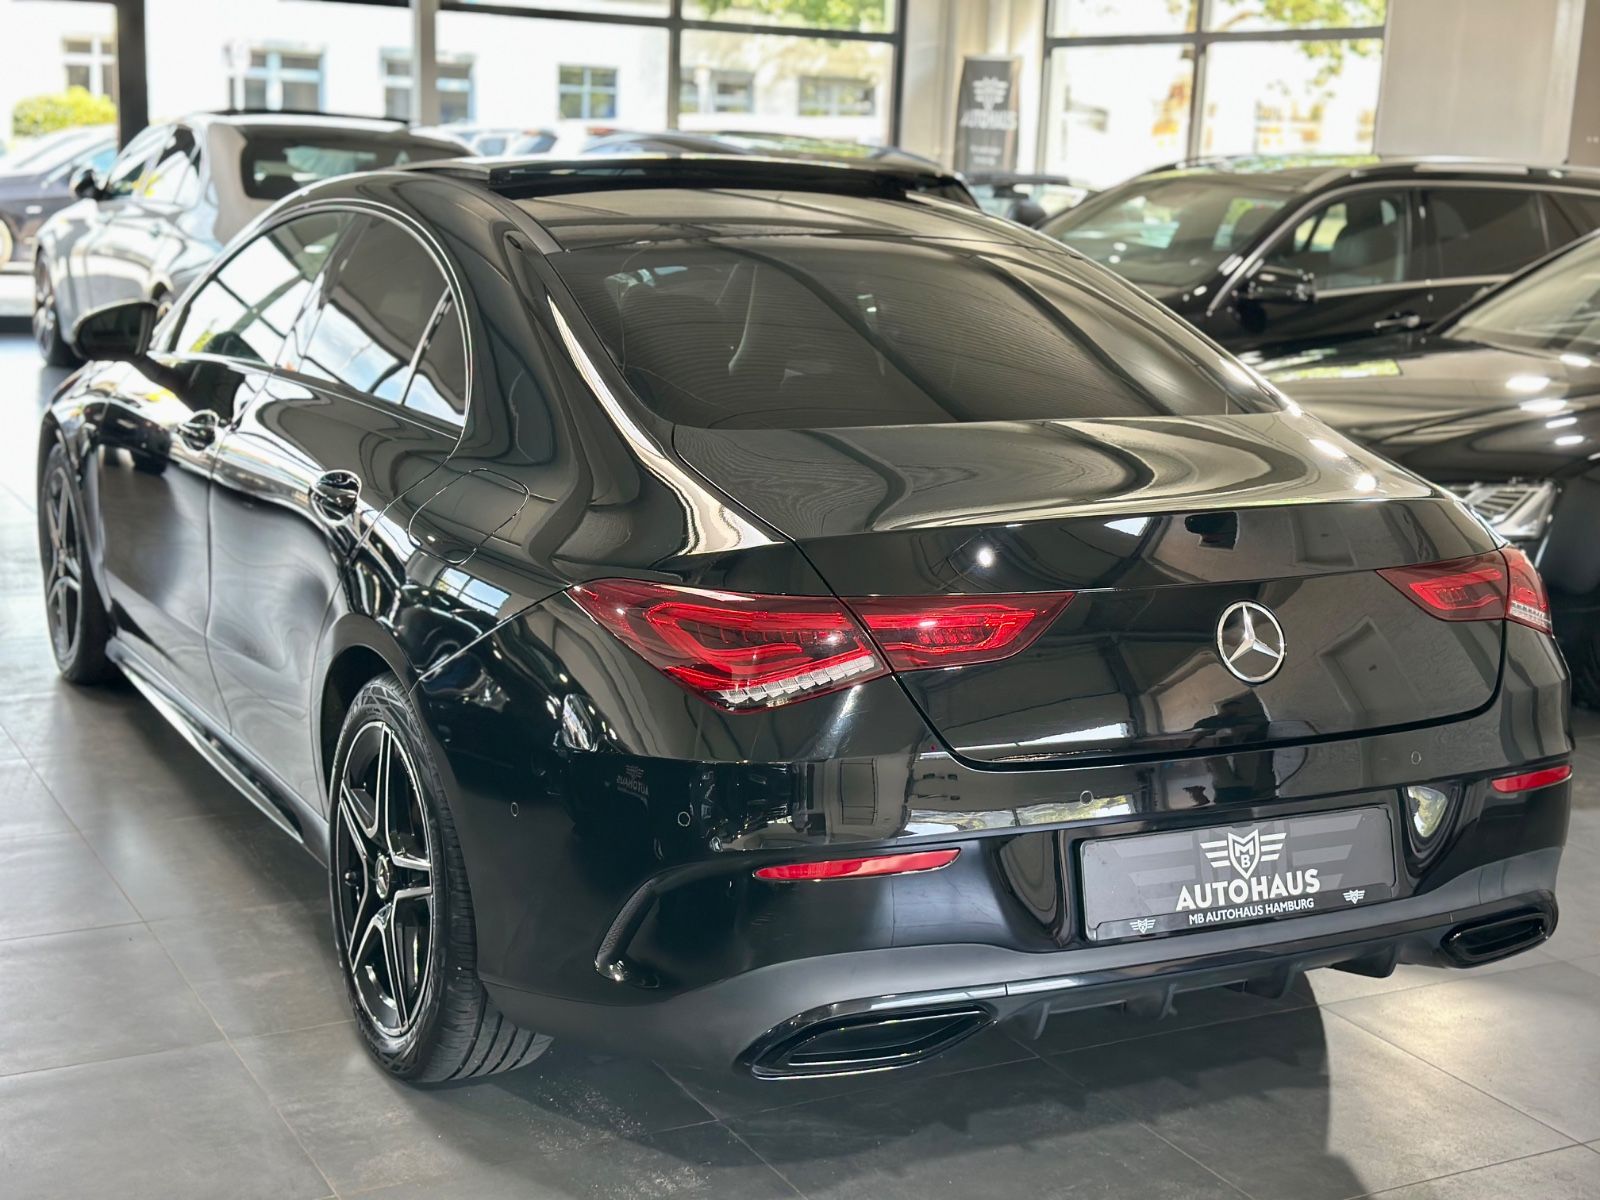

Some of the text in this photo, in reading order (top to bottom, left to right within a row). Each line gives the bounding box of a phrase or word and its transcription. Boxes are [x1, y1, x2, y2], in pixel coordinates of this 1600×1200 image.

[1176, 869, 1320, 911] AUTOHAUS
[1189, 898, 1314, 925] MB AUTOHAUS HAMBURG
